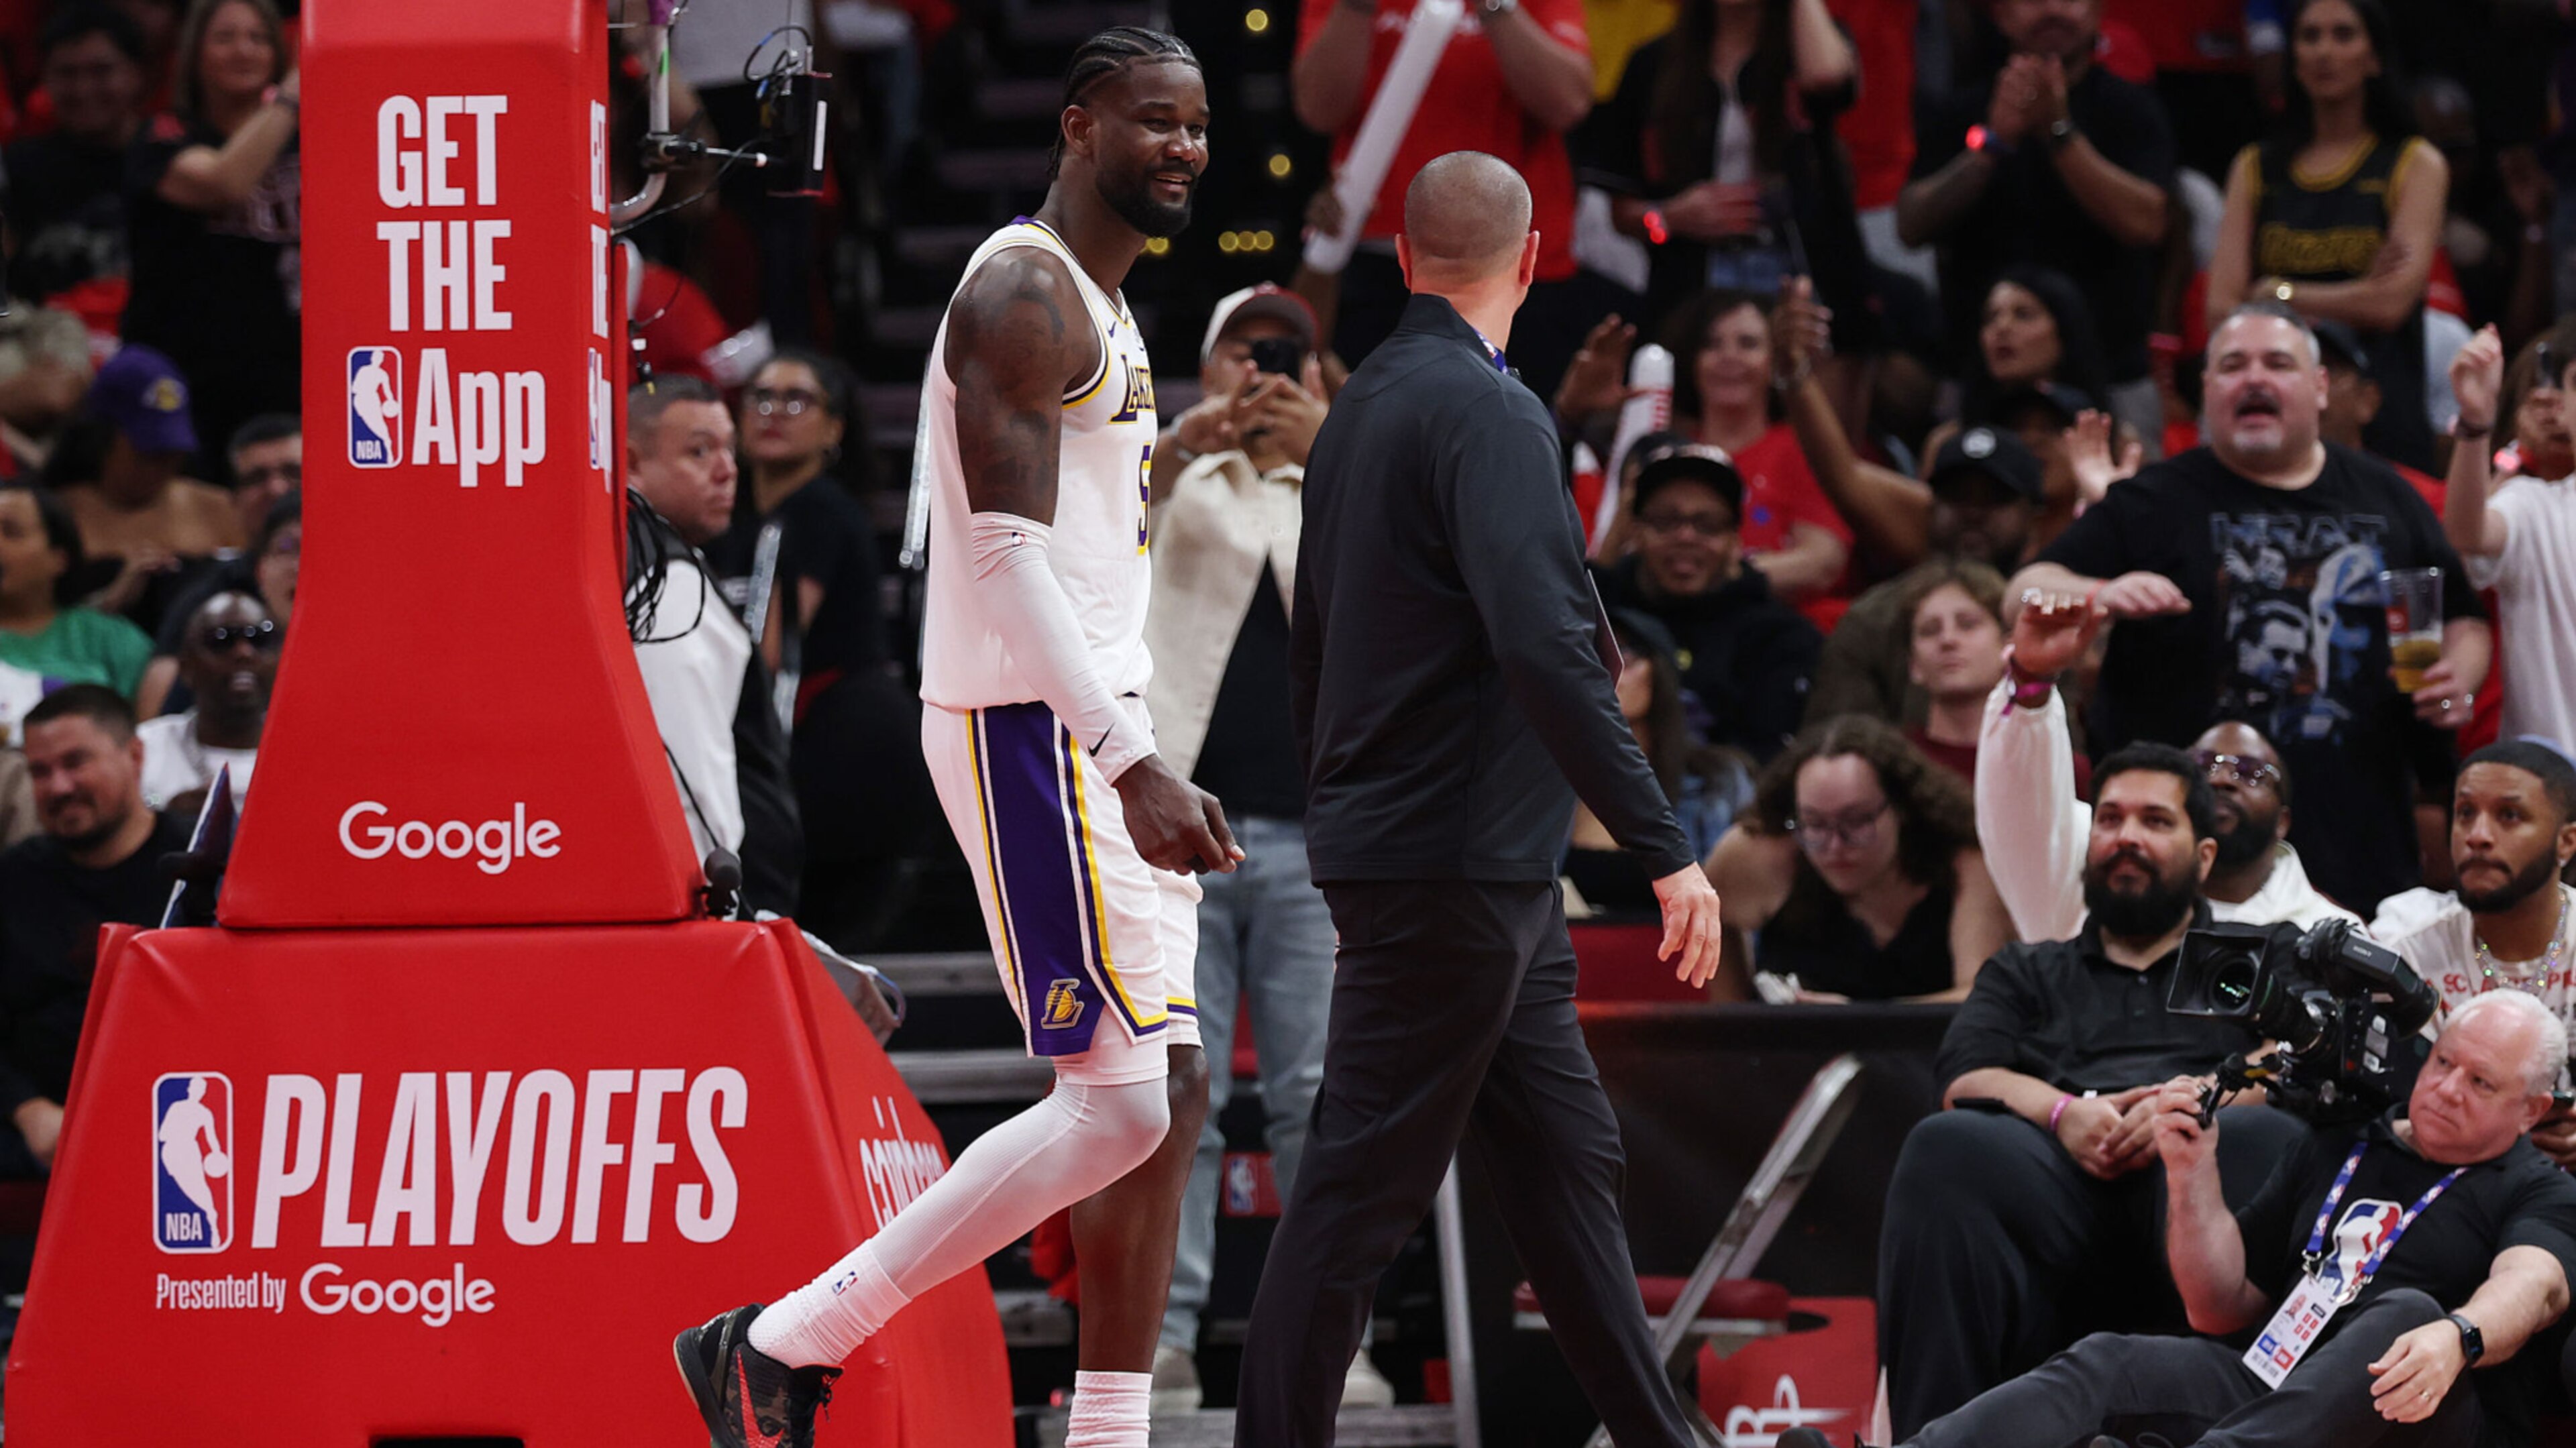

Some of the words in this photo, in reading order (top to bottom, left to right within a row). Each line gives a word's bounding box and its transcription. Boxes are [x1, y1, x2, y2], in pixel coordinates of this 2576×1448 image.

[378, 95, 508, 209] GET
[376, 219, 512, 331] THE
[356, 440, 382, 460] NBA
[412, 348, 546, 488] App
[339, 801, 561, 874] Google
[252, 1066, 748, 1249] PLAYOFFS
[166, 1212, 203, 1241] NBA
[156, 1272, 258, 1309] Presented
[262, 1271, 286, 1314] by
[300, 1262, 495, 1327] Google
